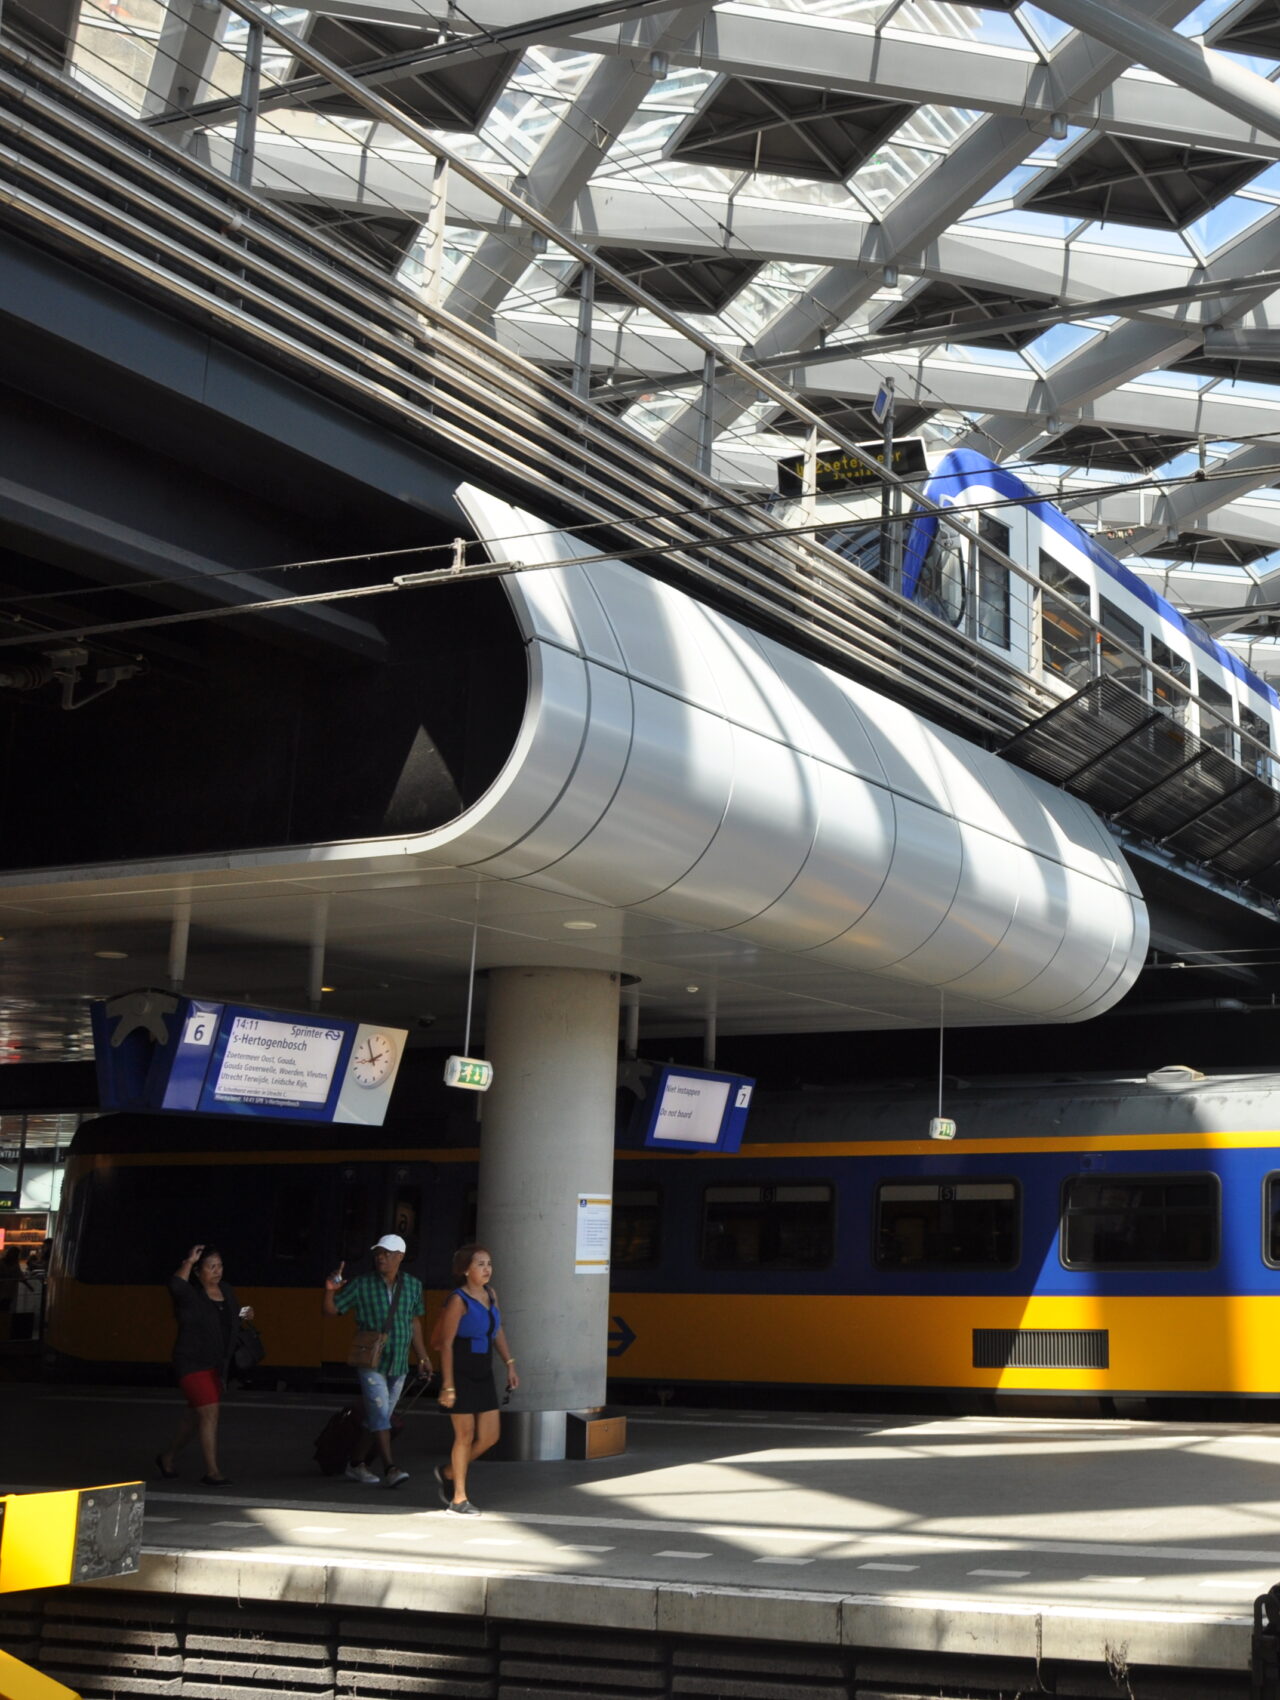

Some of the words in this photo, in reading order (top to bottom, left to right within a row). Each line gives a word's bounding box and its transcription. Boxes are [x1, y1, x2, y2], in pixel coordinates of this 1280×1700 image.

[194, 1024, 206, 1041] 6
[236, 1019, 259, 1030] 14:11
[291, 1025, 323, 1039] Sprinter
[232, 1031, 307, 1051] 's-Hertogenbosch
[227, 1051, 260, 1060] Zoetermeer
[740, 1093, 746, 1105] 7
